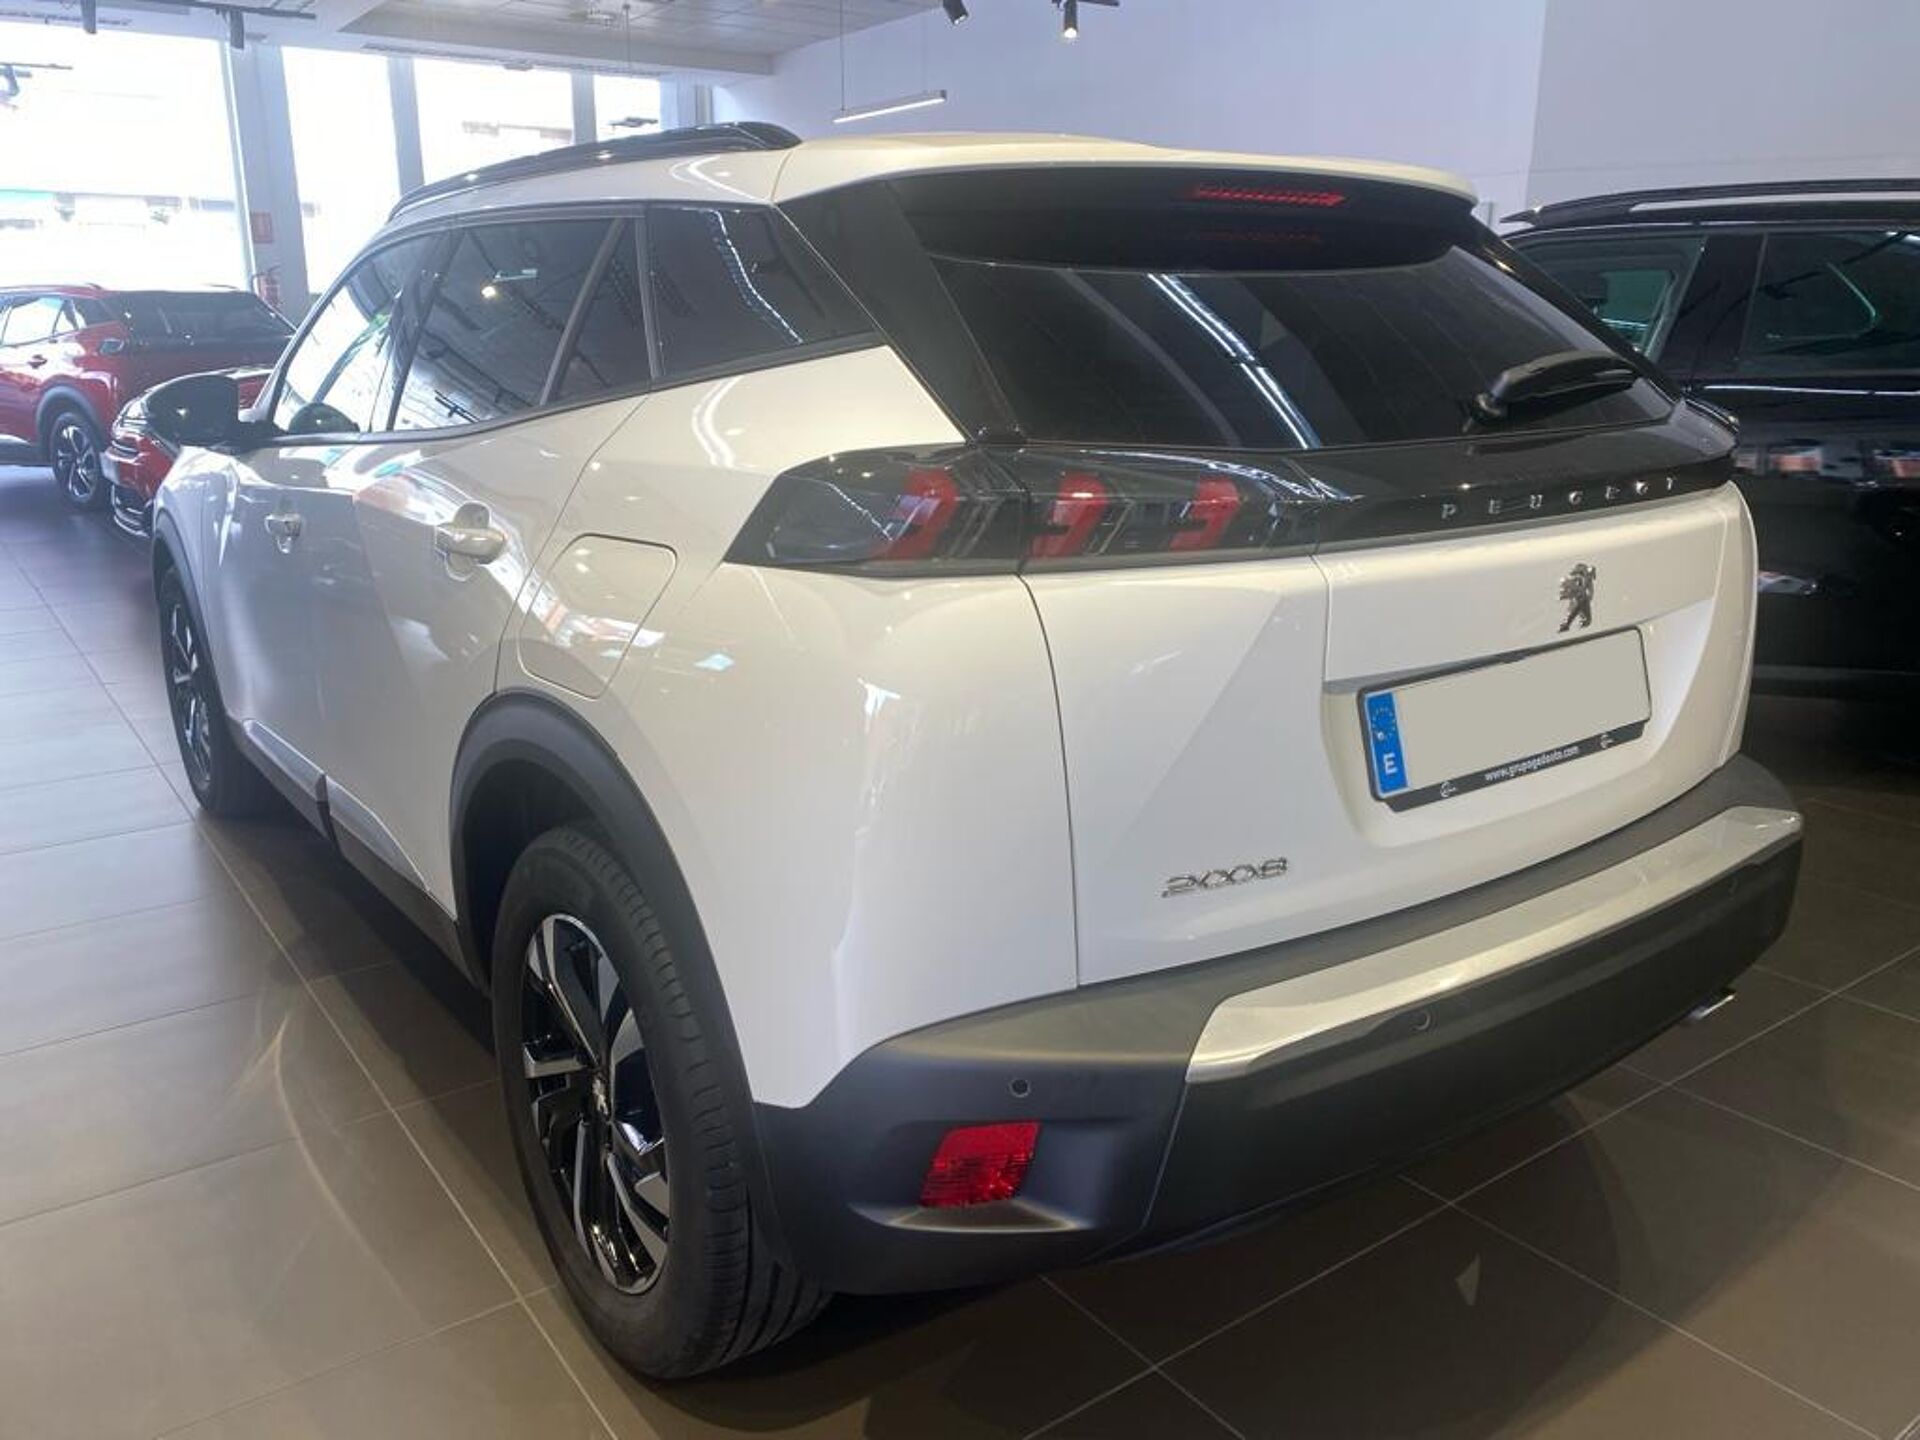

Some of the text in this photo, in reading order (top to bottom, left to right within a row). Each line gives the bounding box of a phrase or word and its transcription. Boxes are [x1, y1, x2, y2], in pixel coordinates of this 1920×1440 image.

[1441, 476, 1677, 520] PEUGEOT
[1382, 753, 1398, 775] E
[1161, 857, 1289, 898] 2008
